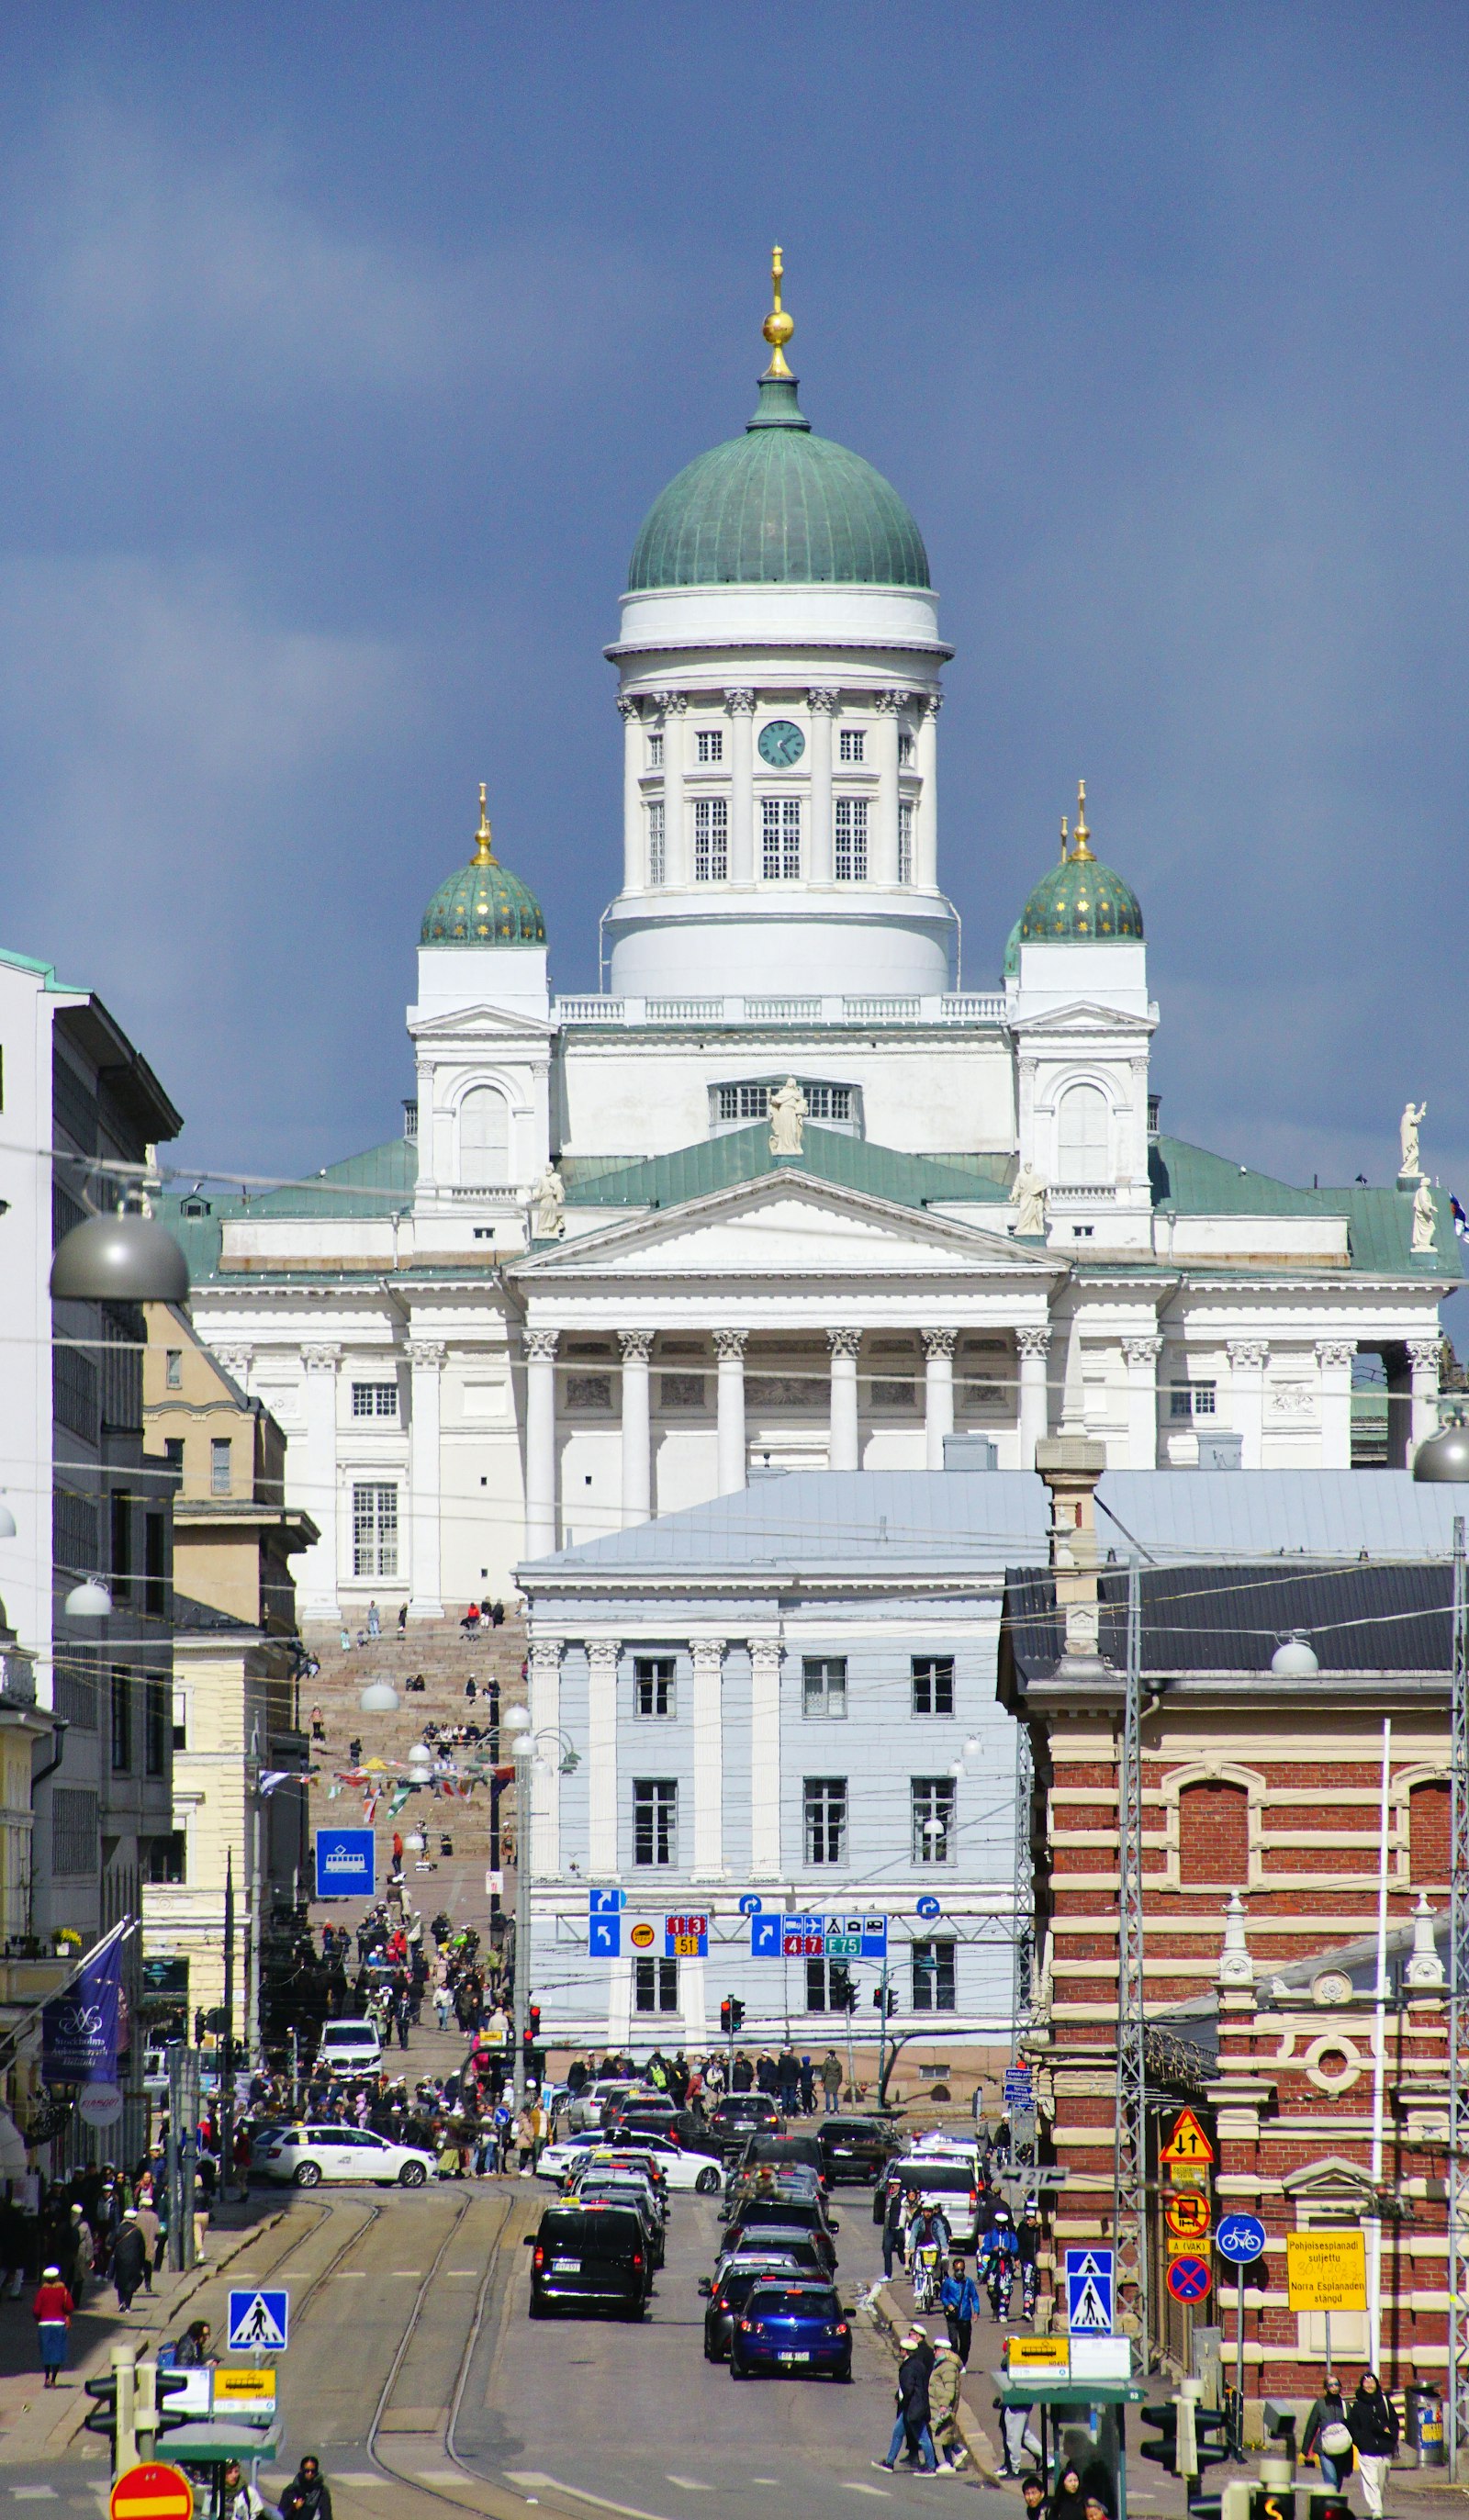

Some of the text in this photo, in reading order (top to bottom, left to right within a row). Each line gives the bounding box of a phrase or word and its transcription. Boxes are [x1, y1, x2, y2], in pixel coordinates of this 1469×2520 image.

[674, 1919, 679, 1932] 1
[692, 1919, 701, 1932] 3
[680, 1939, 693, 1953] 51
[789, 1939, 798, 1953] 4
[810, 1939, 817, 1953] 7
[1183, 2242, 1205, 2251] (VAK)
[1289, 2241, 1359, 2251] Pohjoisesplanadi
[1308, 2254, 1340, 2263] suljettu
[1291, 2281, 1364, 2291] Norra Esplanaden
[1314, 2294, 1342, 2303] stängd
